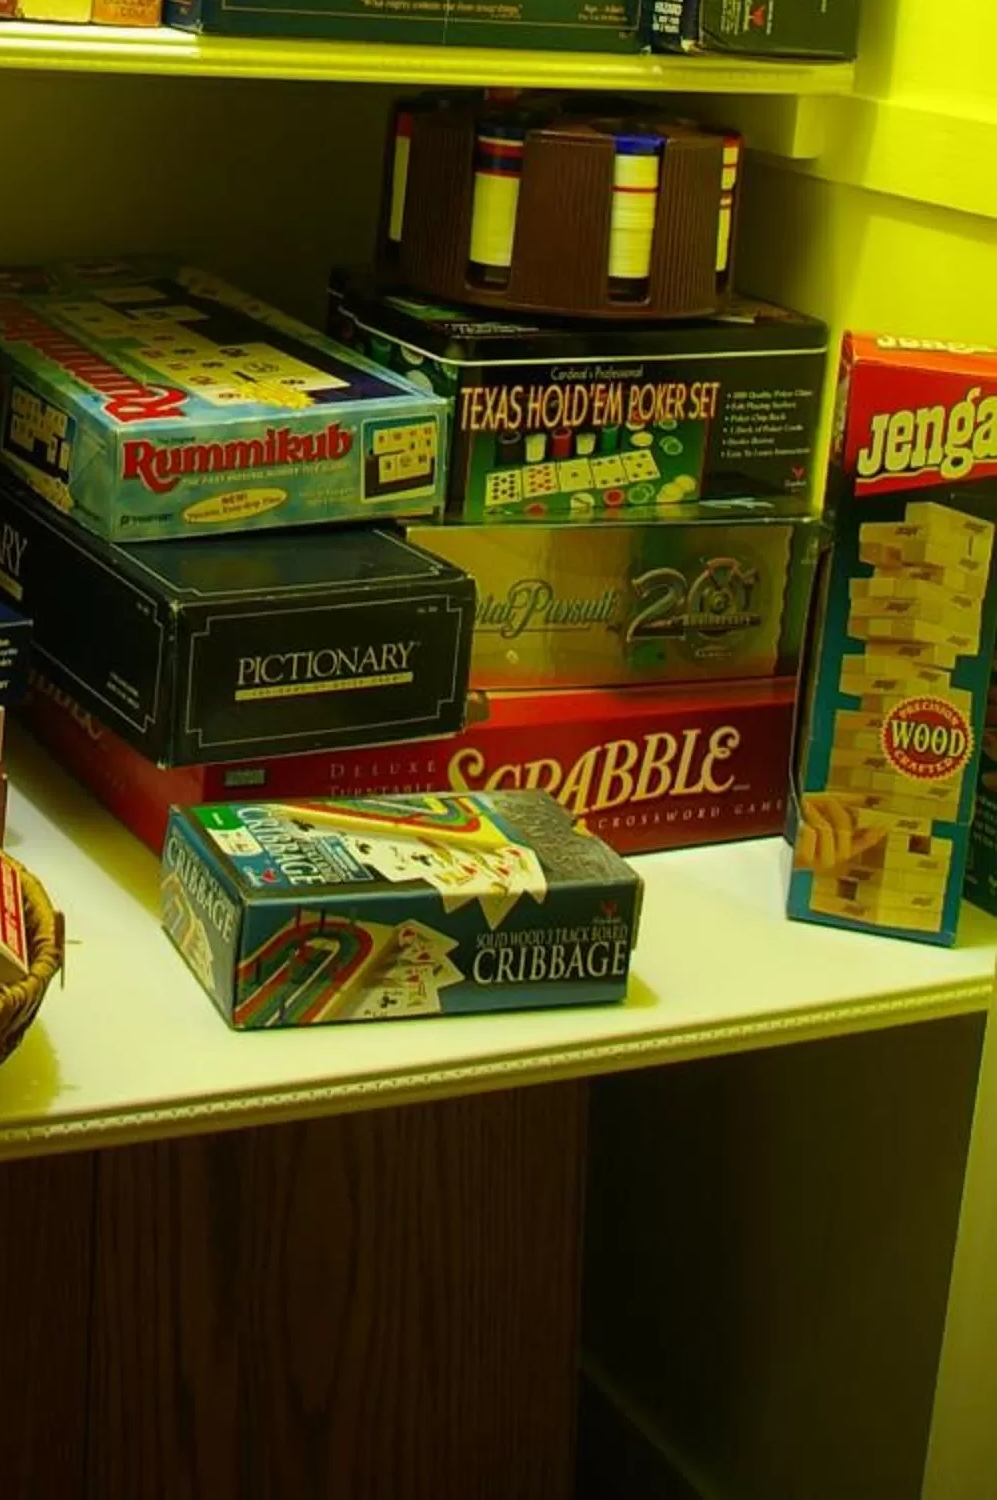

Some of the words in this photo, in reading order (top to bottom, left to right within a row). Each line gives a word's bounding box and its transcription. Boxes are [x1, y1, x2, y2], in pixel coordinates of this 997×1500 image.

[460, 385, 523, 432] TEXAS
[526, 381, 623, 428] HOLD'EM
[626, 382, 687, 424] POKER
[687, 381, 722, 421] SET
[857, 387, 997, 478] Jenga
[122, 421, 354, 493] Rummikub
[238, 640, 415, 686] PICTIONARY
[891, 719, 965, 757] WOOD
[330, 759, 438, 781] DELUXE
[597, 806, 722, 830] CROSSWORD
[472, 940, 628, 986] CRIBBAGE
